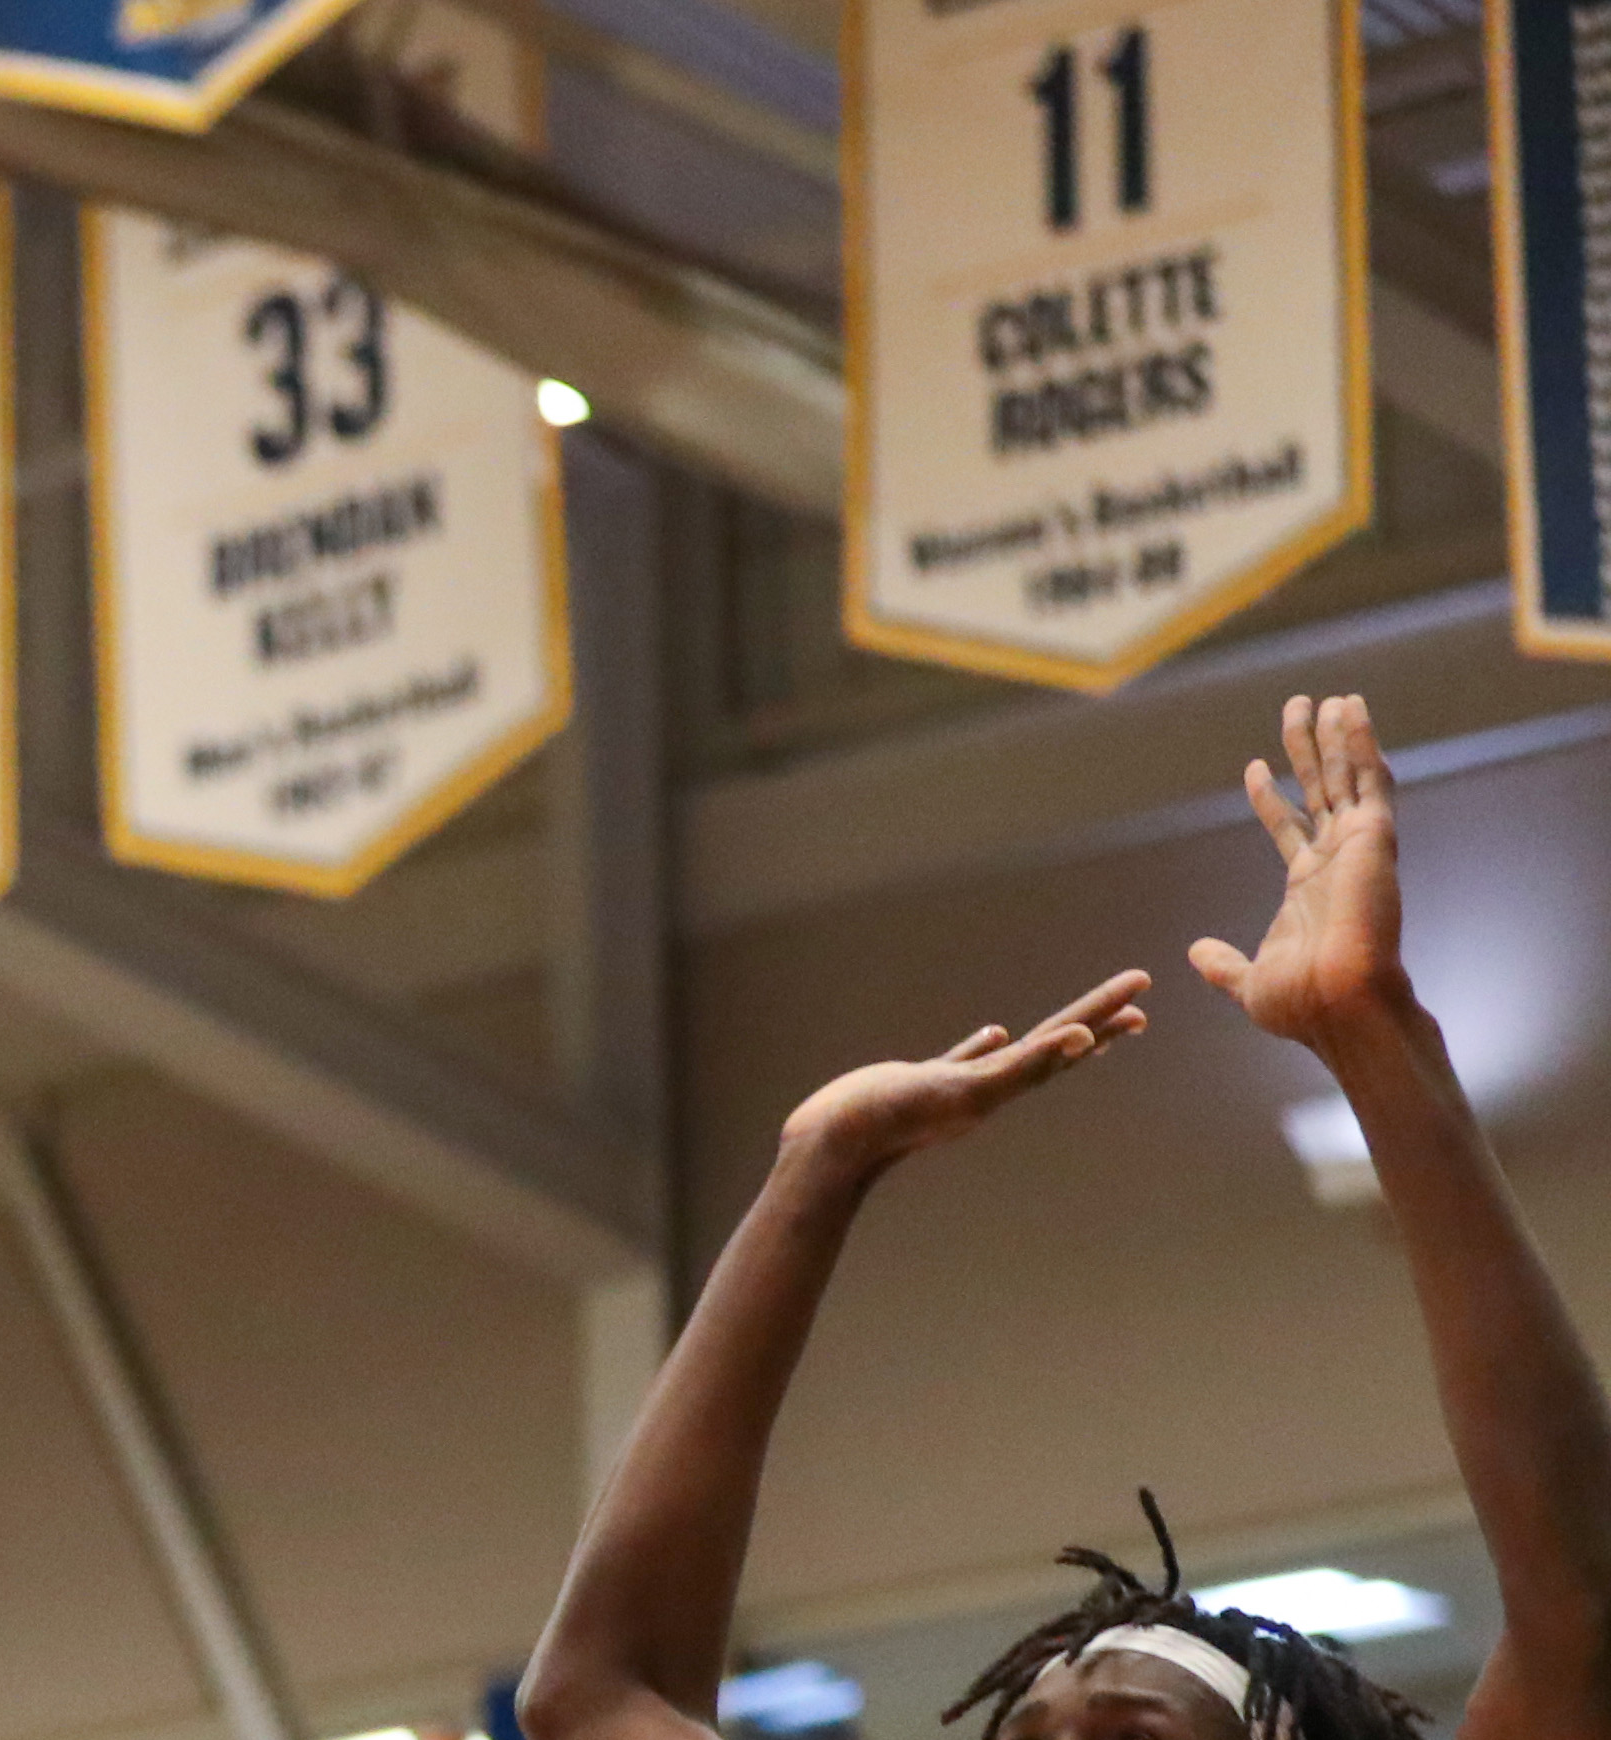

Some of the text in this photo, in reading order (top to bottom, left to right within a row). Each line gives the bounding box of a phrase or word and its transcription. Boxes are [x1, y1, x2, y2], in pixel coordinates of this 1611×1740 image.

[1026, 22, 1151, 236] 11
[245, 278, 391, 468] 33
[980, 246, 1217, 372] COLETTE
[992, 342, 1212, 457] ROGERS
